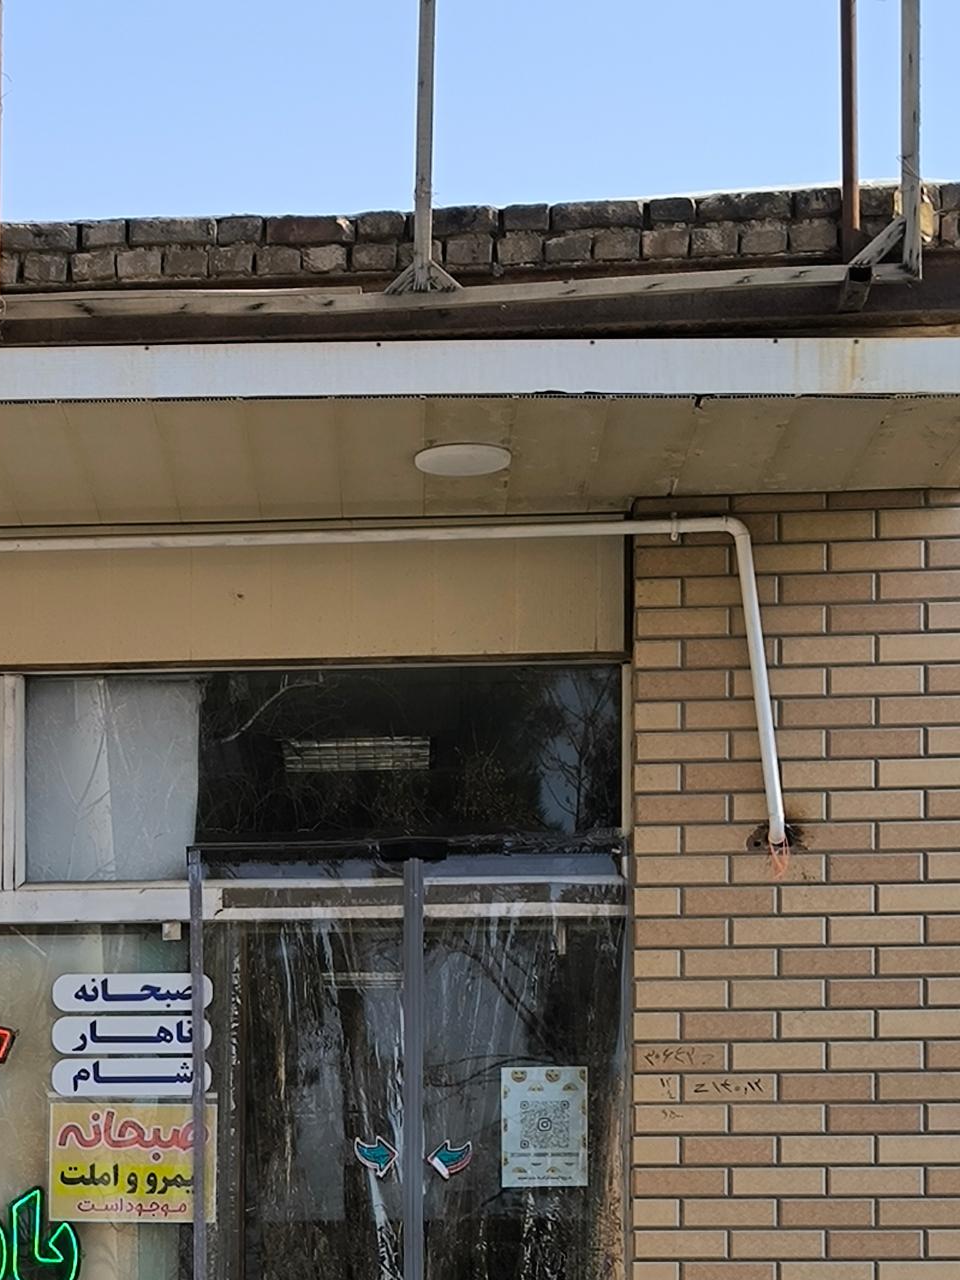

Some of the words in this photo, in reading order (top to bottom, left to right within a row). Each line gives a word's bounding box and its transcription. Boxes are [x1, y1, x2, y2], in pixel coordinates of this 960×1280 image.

[72, 1061, 194, 1092] شام
[59, 1163, 119, 1186] املت
[126, 1171, 139, 1193] و
[146, 1170, 195, 1195] یمرو
